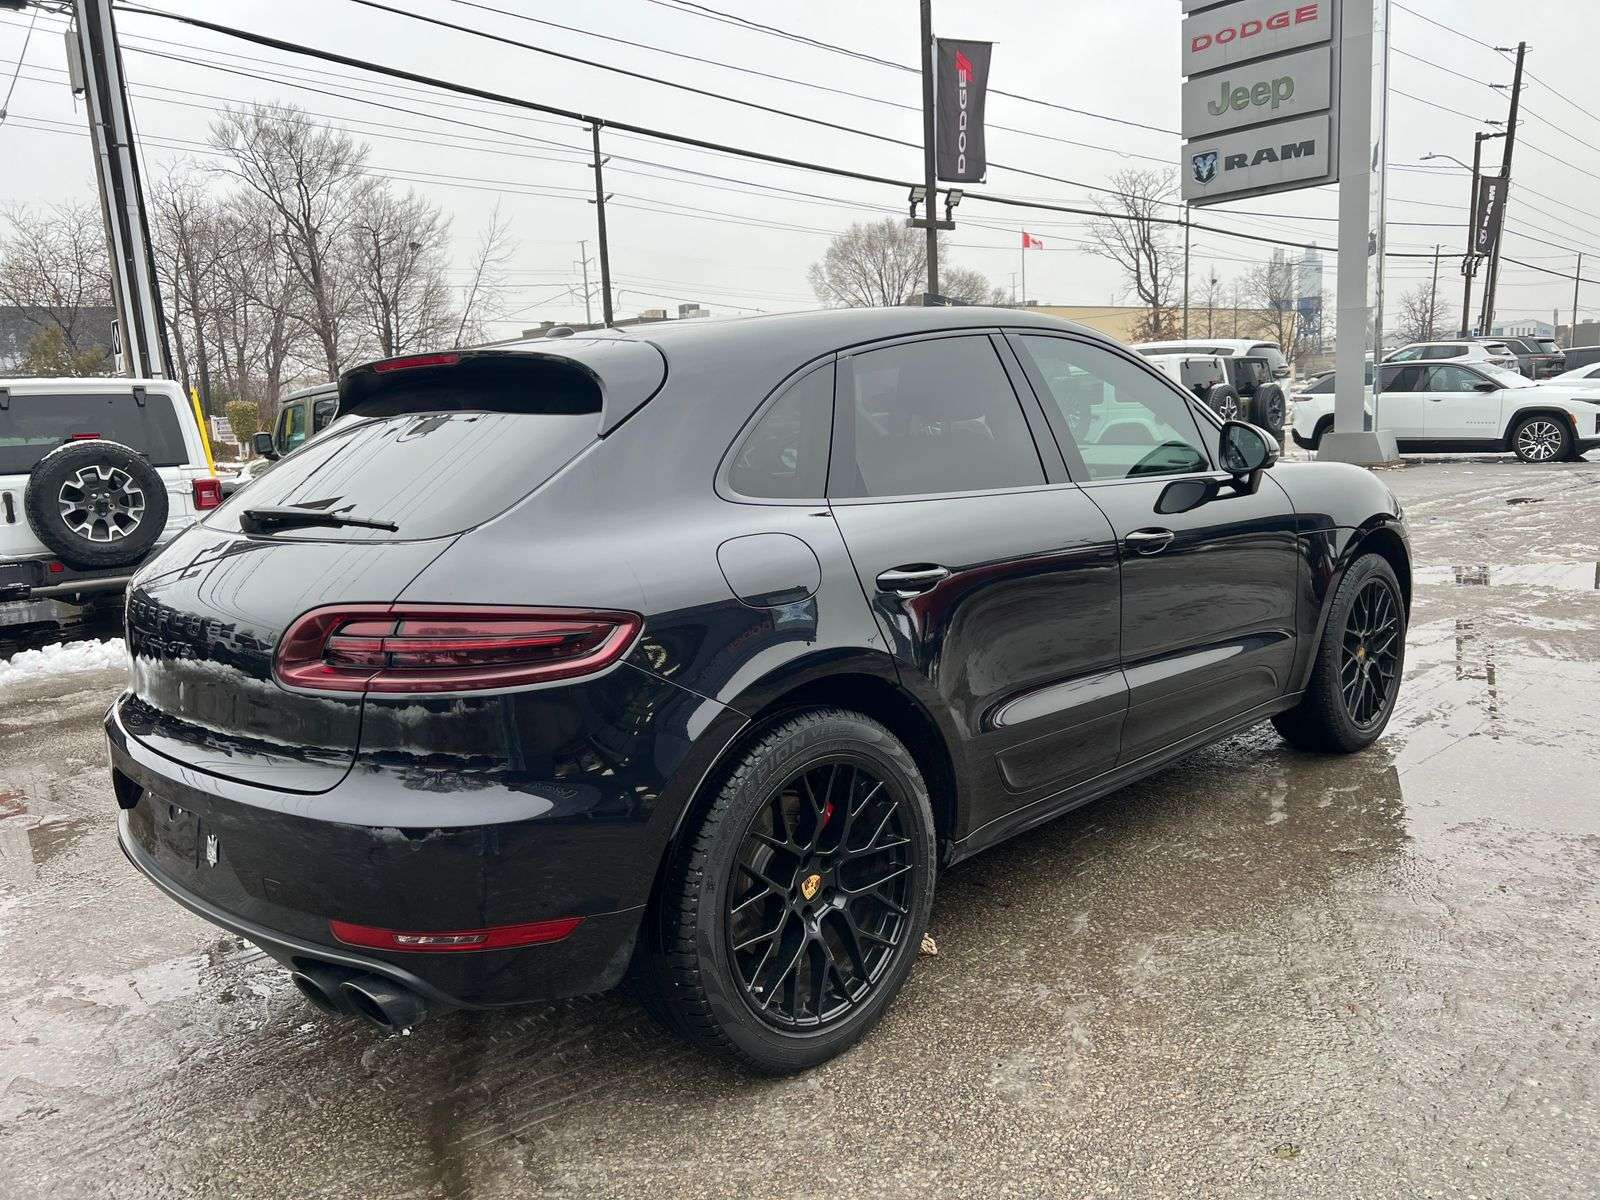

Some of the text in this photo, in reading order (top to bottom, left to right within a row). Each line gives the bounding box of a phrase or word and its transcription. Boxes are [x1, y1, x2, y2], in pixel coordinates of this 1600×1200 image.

[1191, 3, 1319, 53] DODGE
[1207, 75, 1295, 116] Jeep
[957, 68, 968, 174] DODGE
[1224, 139, 1316, 172] RAM
